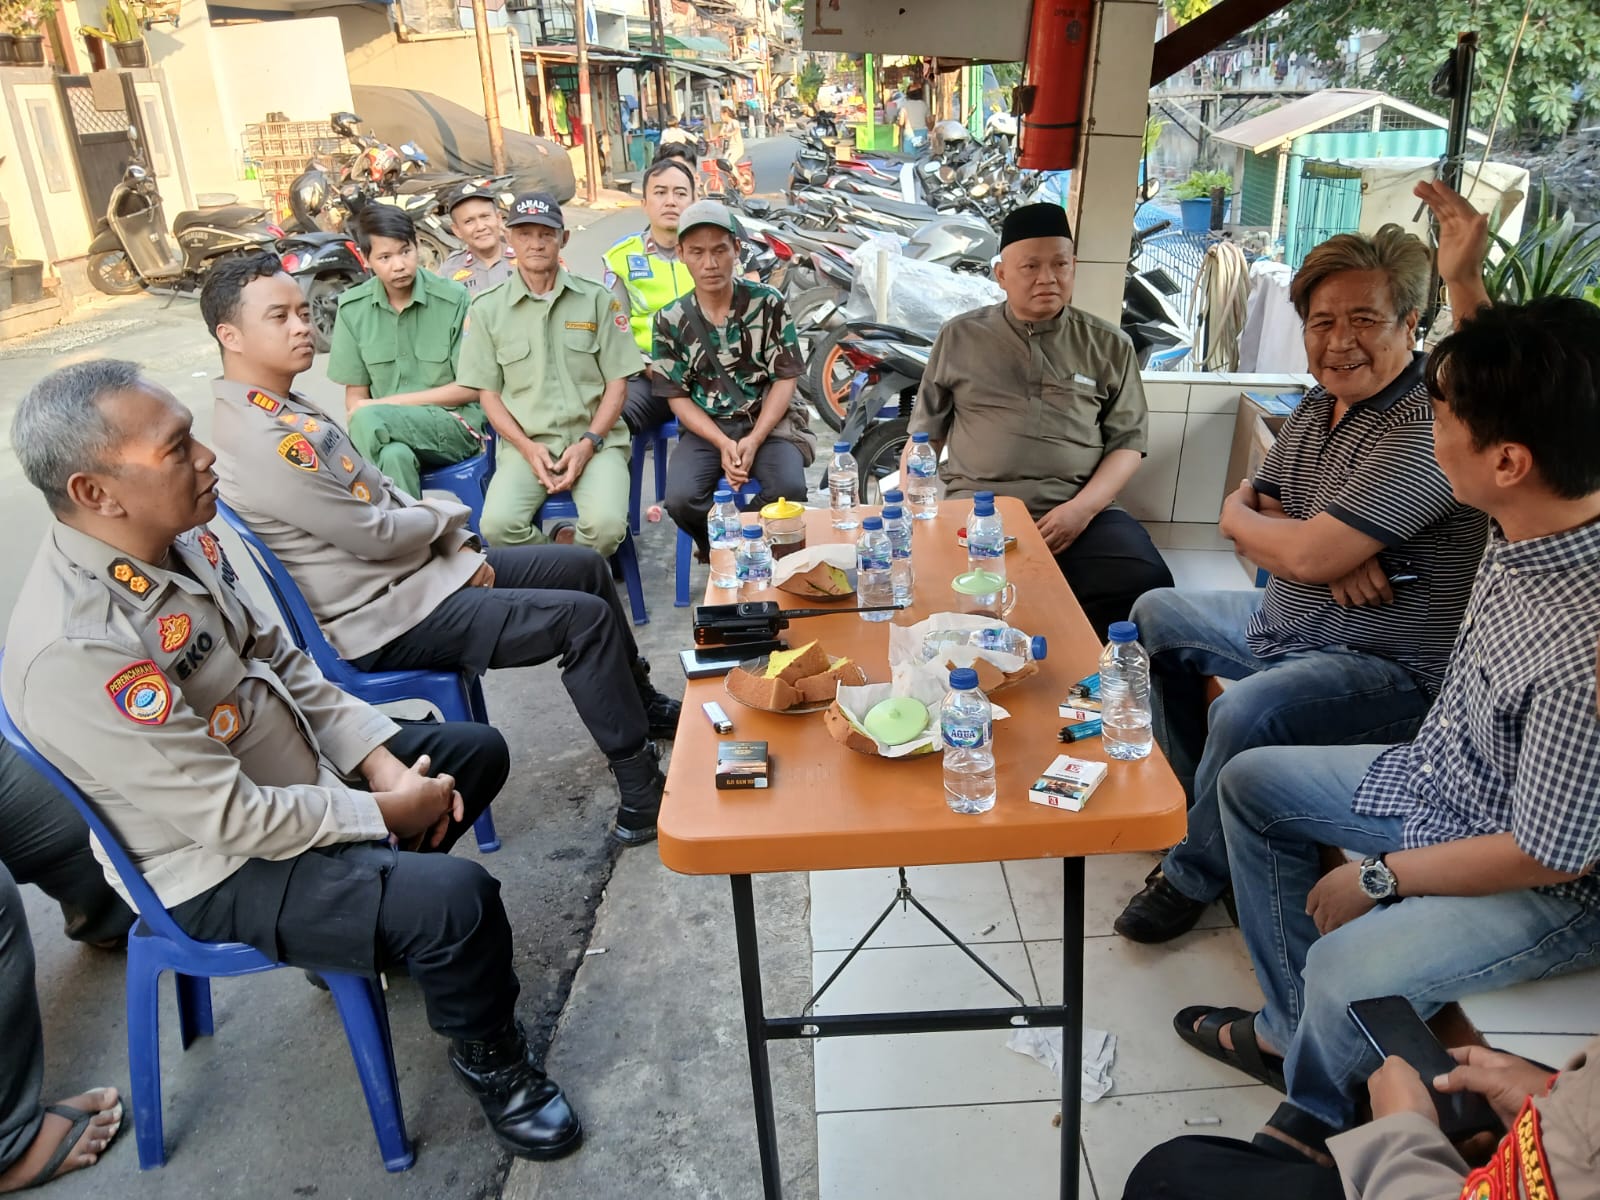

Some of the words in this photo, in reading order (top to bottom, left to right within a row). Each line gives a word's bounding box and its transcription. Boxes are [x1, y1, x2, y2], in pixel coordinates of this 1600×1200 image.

[516, 199, 550, 214] CANADA
[175, 631, 212, 681] EKO
[951, 728, 976, 739] AQUA
